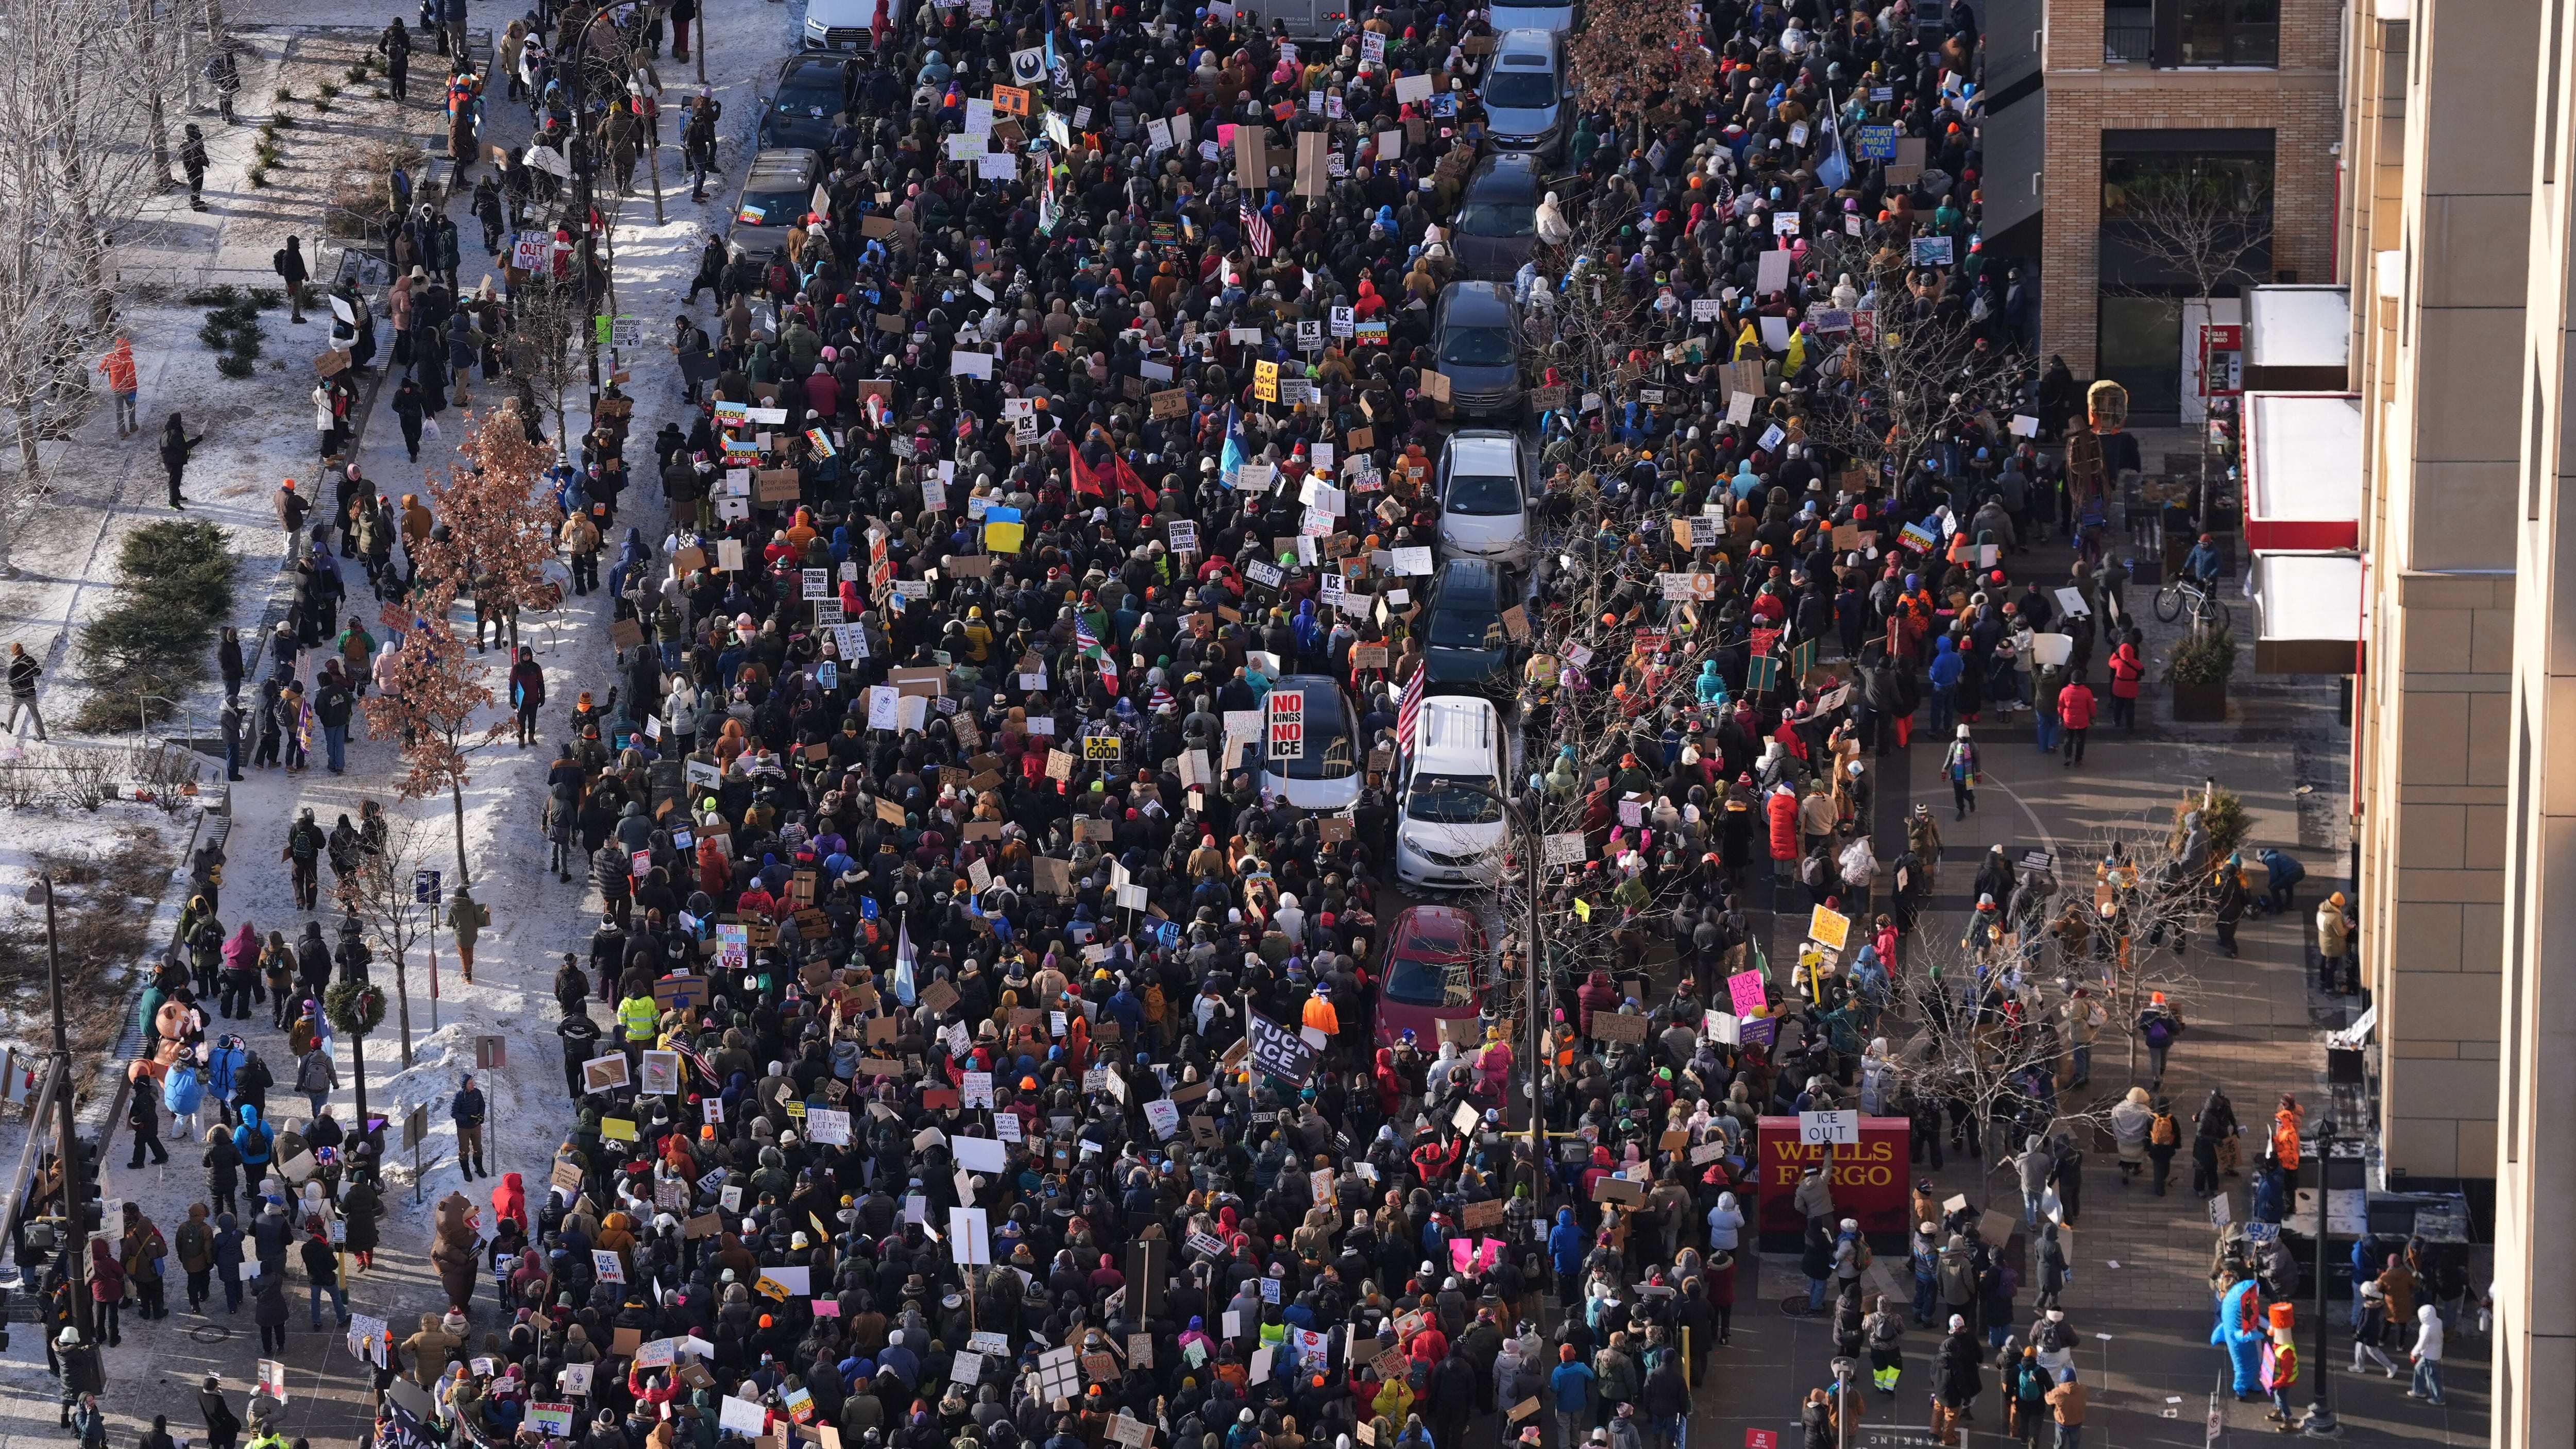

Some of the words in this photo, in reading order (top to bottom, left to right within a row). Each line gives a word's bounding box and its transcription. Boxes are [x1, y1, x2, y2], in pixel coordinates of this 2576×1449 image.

[1150, 122, 1163, 130] HOT
[1156, 140, 1170, 149] ICE
[1862, 137, 1879, 146] MAD
[1879, 137, 1890, 145] AT
[1649, 144, 1660, 162] LEAVE
[524, 231, 547, 246] ICE
[520, 243, 547, 257] OUT
[1694, 302, 1704, 310] ICE
[1705, 301, 1718, 310] OUT
[1302, 322, 1316, 335] ICE
[1259, 363, 1273, 375] GO
[1256, 375, 1276, 386] HOME
[1255, 385, 1274, 399] NAZI
[1020, 416, 1032, 430] ICE
[810, 430, 821, 442] ICE
[819, 442, 831, 458] OUT
[1016, 433, 1038, 442] MINNESOTA
[1314, 444, 1331, 454] ICE
[1312, 455, 1331, 465] OUT
[1353, 470, 1369, 480] REST
[1371, 468, 1381, 476] IN
[1357, 476, 1379, 486] POWER
[1354, 484, 1372, 493] RENEE
[1170, 522, 1193, 531] GENERAL
[1171, 529, 1193, 537] STRIKE:
[1901, 529, 1914, 540] ICE
[1915, 536, 1933, 549] OUT
[1903, 538, 1922, 552] MSP
[872, 538, 886, 564] NO
[1172, 542, 1194, 551] JUSTICE
[1401, 547, 1425, 559] ICE
[873, 553, 887, 574] KINGS
[1251, 561, 1265, 574] ICE
[1266, 564, 1283, 578] OUT
[1396, 557, 1432, 571] GTFO
[804, 576, 827, 585] STRIKE:
[874, 562, 889, 590] NO
[1253, 572, 1276, 586] NOW
[877, 577, 891, 603] ICE
[820, 618, 843, 626] JUSTICE
[1651, 626, 1669, 635] ICE
[822, 663, 836, 676] ICE
[823, 676, 836, 689] OUT
[1273, 694, 1302, 713] NO
[1273, 712, 1301, 724] KINGS
[1272, 723, 1301, 741] NO
[1091, 737, 1109, 747] BE
[1272, 740, 1301, 757] ICE
[1087, 746, 1118, 759] GOOD
[1163, 922, 1180, 939] ICE
[1160, 933, 1176, 949] OUT
[1731, 973, 1758, 990] FUCK
[1735, 995, 1761, 1010] SKOL
[1602, 1022, 1631, 1032] INCEL
[1254, 1037, 1296, 1070] ICE
[1088, 1069, 1106, 1079] GET
[1109, 1071, 1125, 1089] GET
[1108, 1081, 1124, 1098] OUT
[810, 1111, 831, 1122] HATE
[833, 1113, 849, 1124] WILL
[1252, 1113, 1265, 1123] GET
[1265, 1112, 1277, 1122] OUT
[1817, 1113, 1838, 1124] ICE
[812, 1122, 826, 1130] NOT
[828, 1122, 846, 1131] MAKE
[811, 1130, 824, 1138] US
[825, 1131, 846, 1140] GREAT
[1808, 1126, 1846, 1141] OUT
[1772, 1141, 1892, 1162] WELLS
[597, 1255, 613, 1265] ICE
[599, 1264, 616, 1273] OUT
[601, 1271, 621, 1281] NOW!
[352, 1314, 385, 1330] JUSTICE
[351, 1330, 382, 1343] GOOD
[352, 1322, 382, 1338] RENEE
[973, 1332, 1006, 1345] ABOLISH
[1303, 1335, 1318, 1343] STOP
[978, 1341, 1001, 1354] ICE
[1308, 1350, 1325, 1363] ICE
[1371, 1356, 1380, 1365] NO
[1380, 1348, 1395, 1360] ONE
[1382, 1352, 1404, 1367] ILLEGAL
[1386, 1359, 1409, 1376] STOLEN
[532, 1403, 550, 1411] HOT
[551, 1403, 573, 1414] DISH
[789, 1404, 801, 1415] ICE
[799, 1397, 812, 1410] OUT
[797, 1408, 811, 1421] MSP
[536, 1420, 561, 1435] ICE
